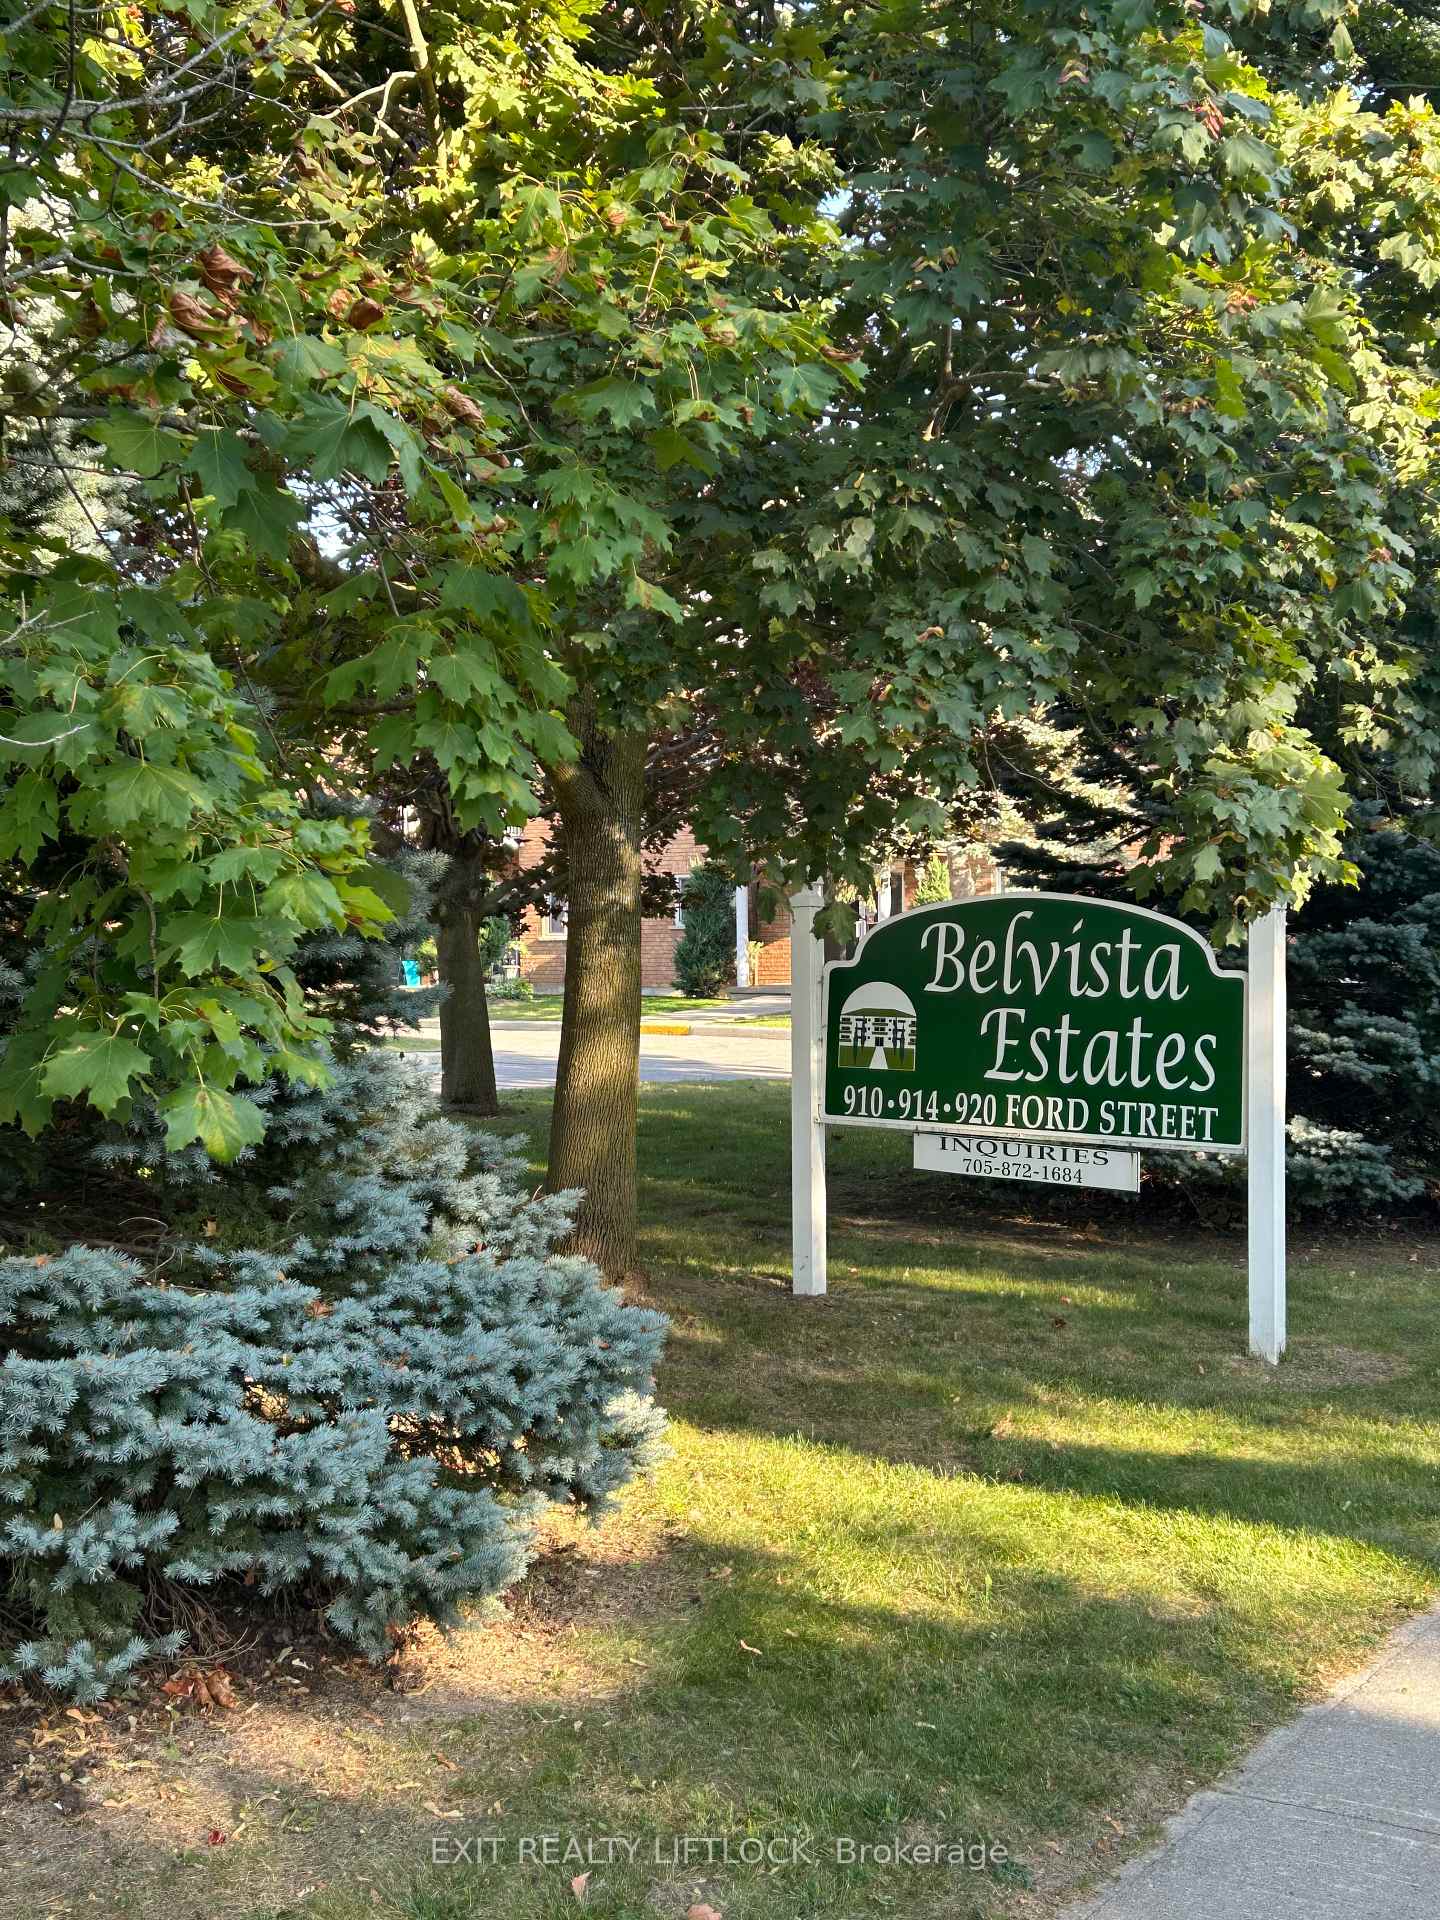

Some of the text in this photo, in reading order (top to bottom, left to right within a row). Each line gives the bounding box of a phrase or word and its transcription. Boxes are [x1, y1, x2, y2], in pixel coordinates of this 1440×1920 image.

[920, 910, 1190, 1001] Belvista
[980, 1008, 1217, 1092] Estates
[1005, 1094, 1089, 1131] FORD
[1099, 1100, 1219, 1141] STREET
[939, 1136, 1109, 1166] INQUIRIES
[962, 1158, 1083, 1184] 705-872-1684
